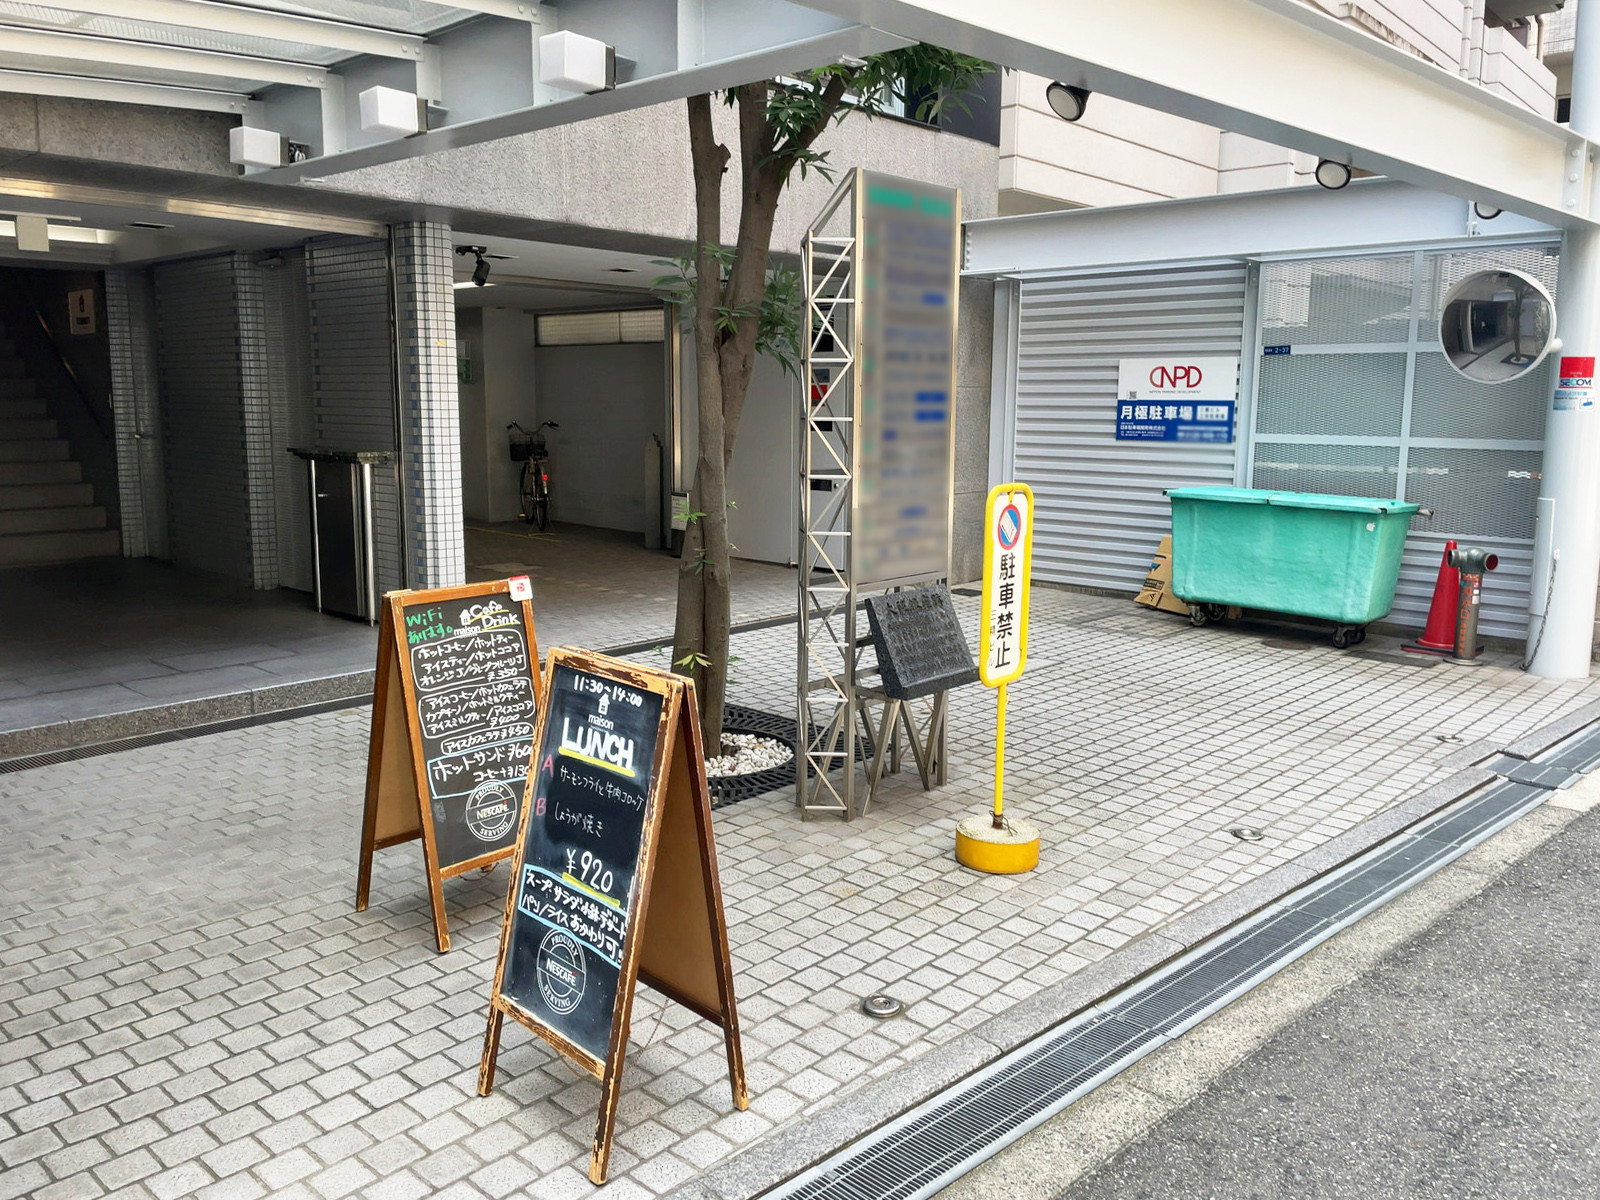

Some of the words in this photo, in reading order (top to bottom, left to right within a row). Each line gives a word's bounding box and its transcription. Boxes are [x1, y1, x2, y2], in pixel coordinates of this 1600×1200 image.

[1560, 378, 1592, 387] SECOM
[406, 607, 443, 627] WiFi
[995, 552, 1016, 669] 駐車禁止
[453, 624, 482, 637] maison
[482, 613, 520, 629] Drink
[588, 714, 614, 730] maison
[561, 716, 634, 770] LUNCH
[542, 754, 554, 777] A
[474, 784, 505, 801] PROUDLY
[536, 797, 547, 816] B
[480, 821, 508, 836] SERVING
[554, 802, 604, 838] しょうが焼き
[566, 848, 614, 894] ¥920
[551, 934, 579, 957] PROUDLY
[544, 984, 571, 1008] SERVING
